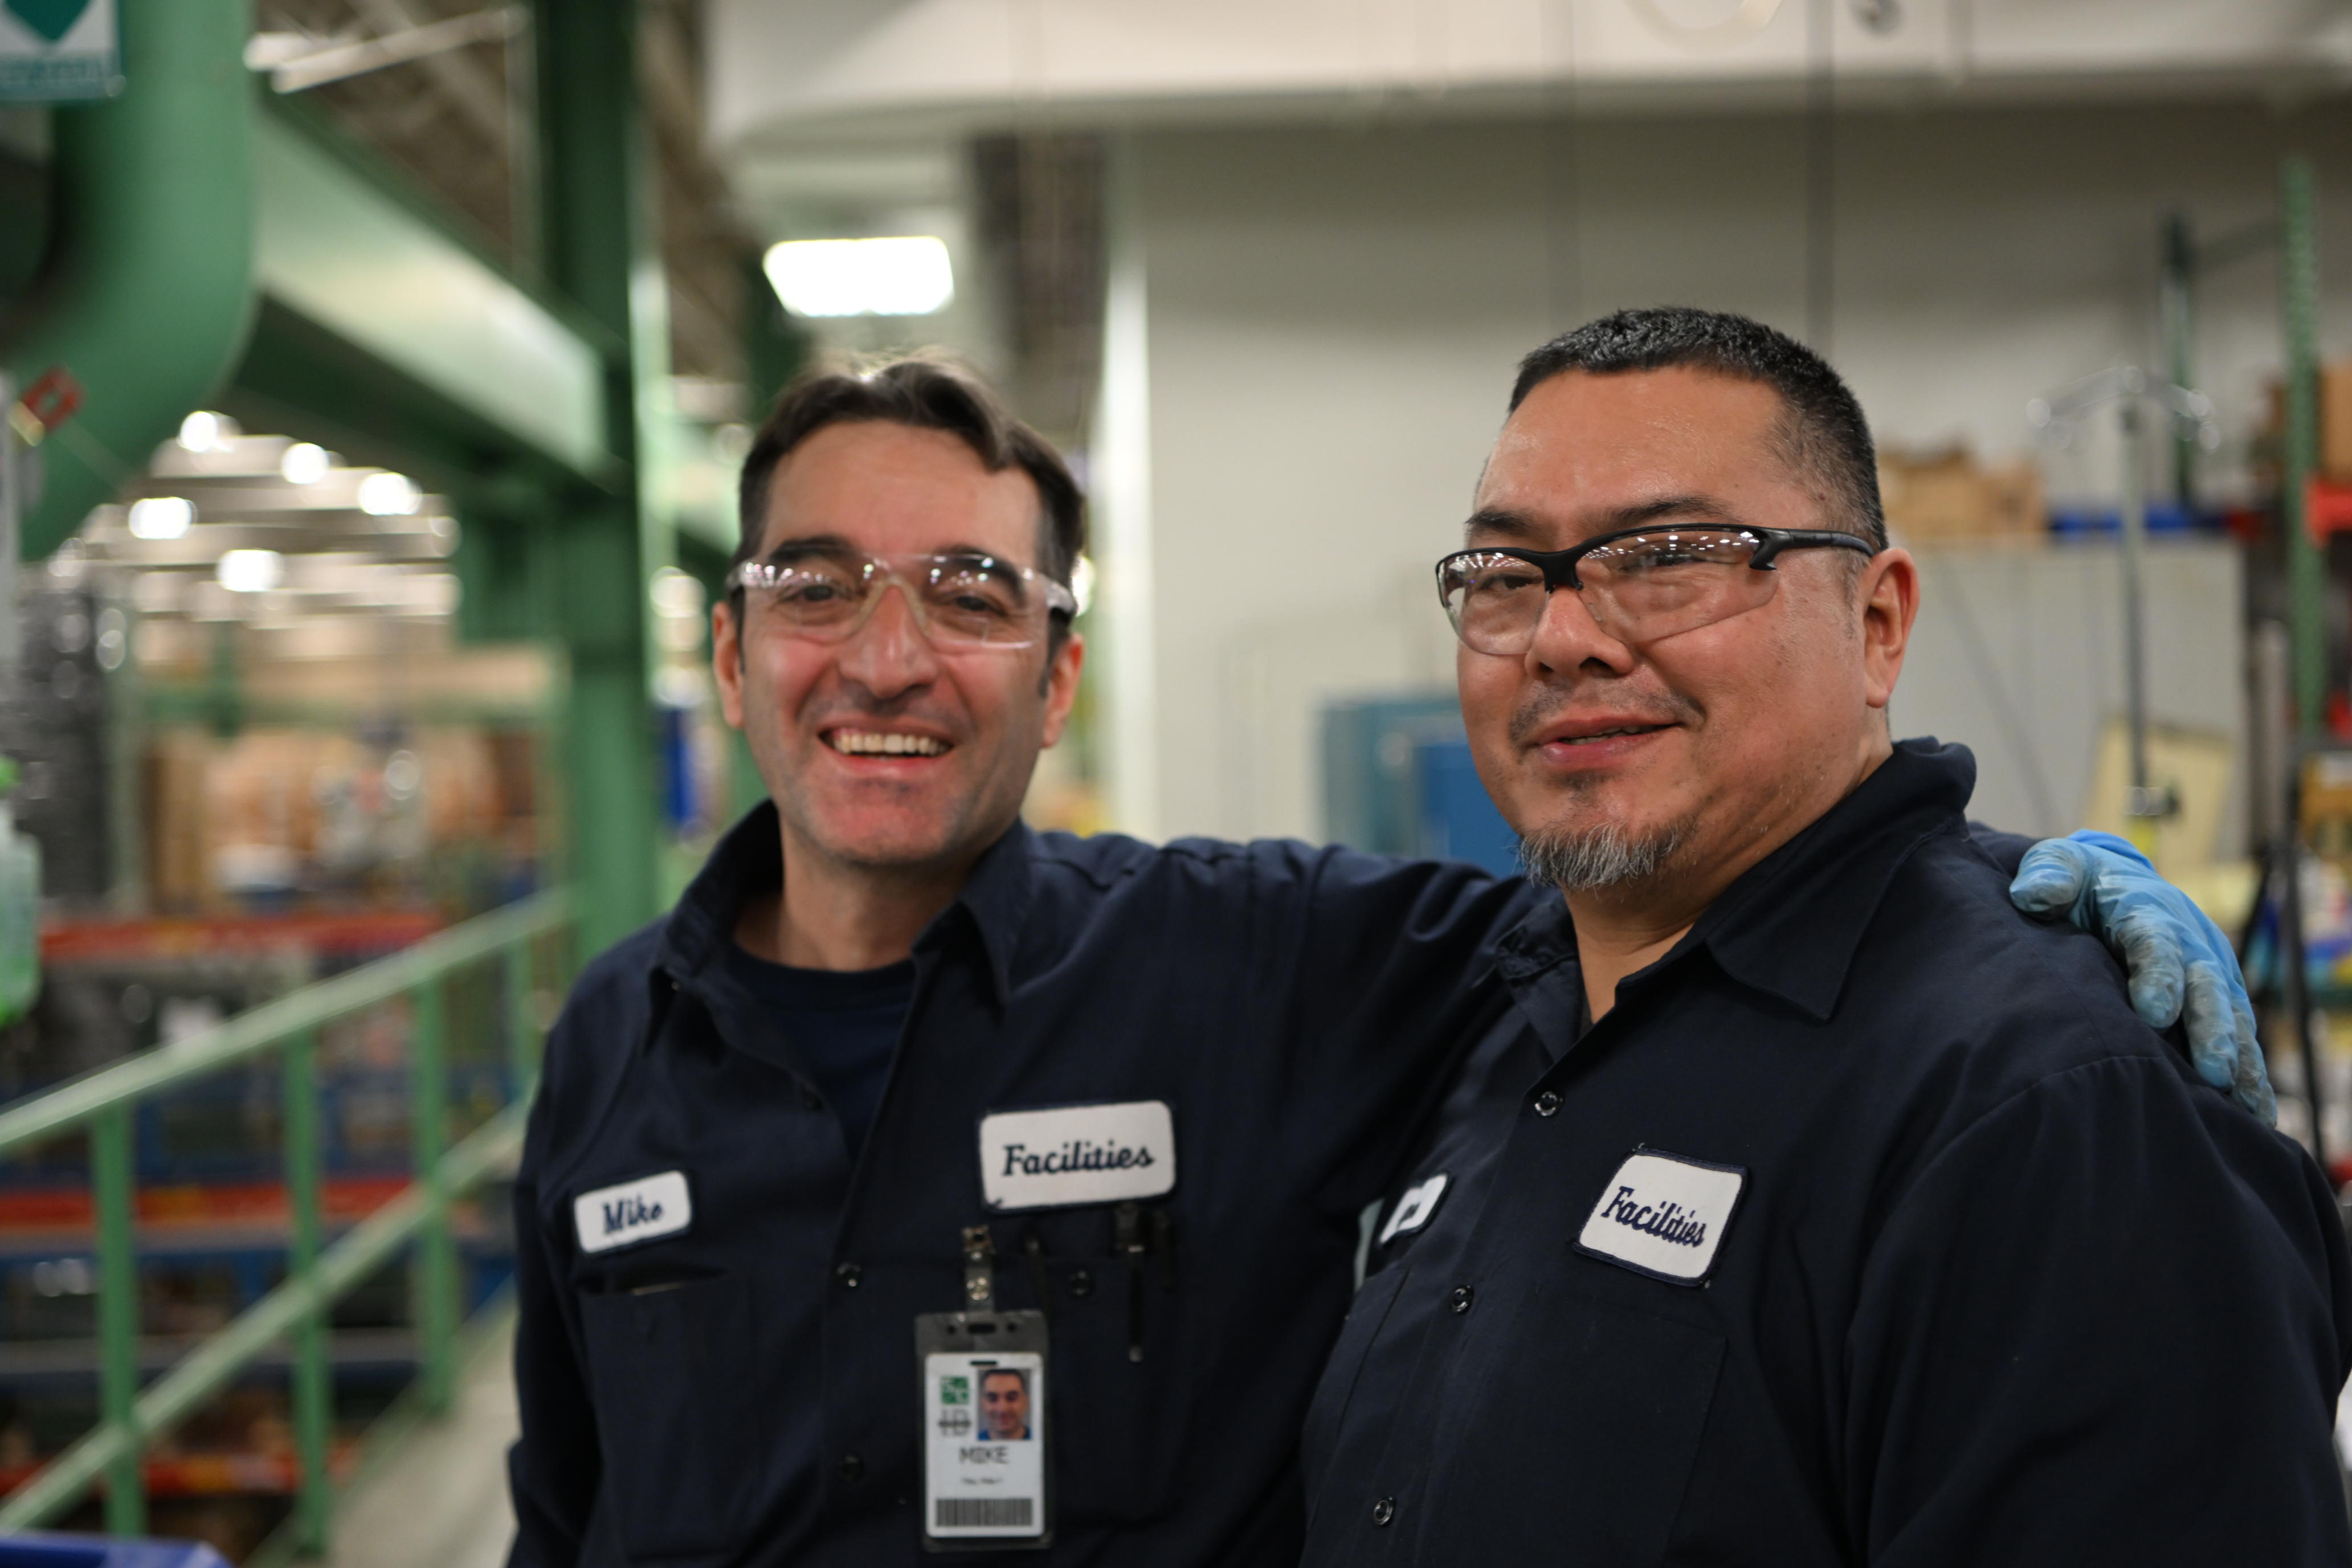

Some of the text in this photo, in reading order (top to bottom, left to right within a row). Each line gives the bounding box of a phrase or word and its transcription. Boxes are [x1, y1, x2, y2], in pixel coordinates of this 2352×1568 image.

[1002, 1139, 1155, 1176] Facilities
[603, 1194, 663, 1235] Mike
[1600, 1186, 1706, 1248] Facilities
[958, 1446, 1008, 1464] MIKE
